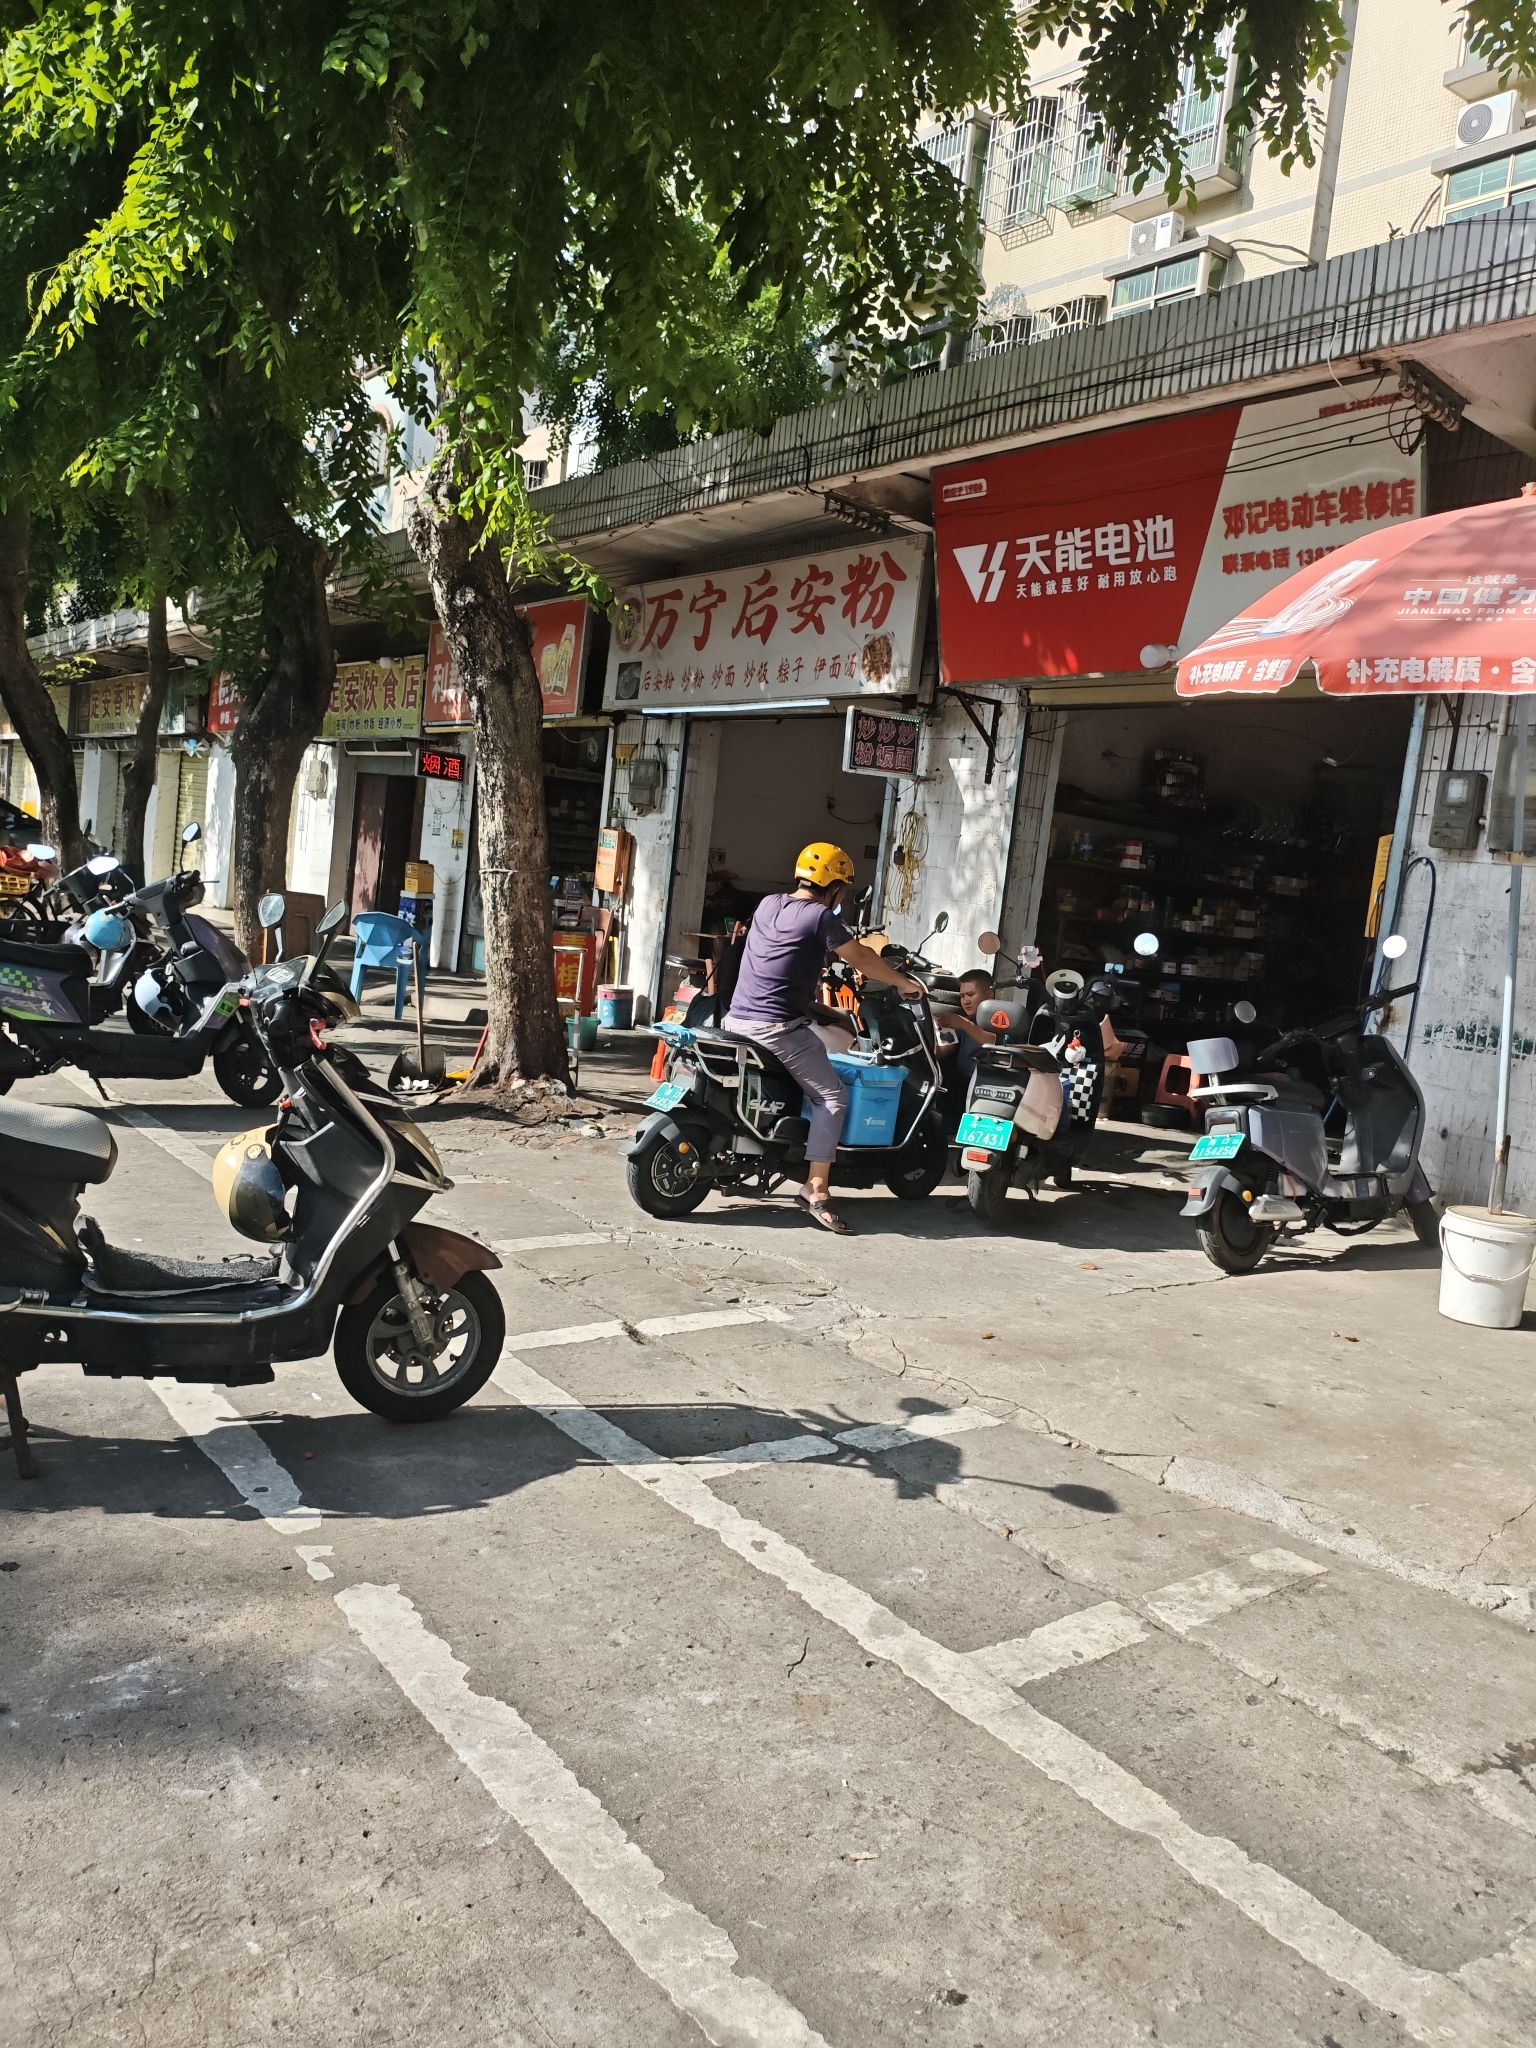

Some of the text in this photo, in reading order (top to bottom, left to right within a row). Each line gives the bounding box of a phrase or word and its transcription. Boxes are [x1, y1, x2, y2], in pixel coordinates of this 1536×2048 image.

[1223, 478, 1415, 540] 邓记电动车维修店
[1016, 515, 1175, 579] 天能电池
[1222, 547, 1290, 575] 联系电话
[1016, 565, 1178, 600] 天能就是好 耐用放心跑
[1465, 574, 1518, 585] 这就是
[638, 551, 908, 652] 万宁后安粉
[1397, 607, 1471, 615] JIANLIBAO
[1477, 607, 1517, 615] FROM
[641, 667, 675, 692] 后安粉
[681, 665, 705, 692] 炒粉
[711, 663, 736, 690] 炒面
[743, 660, 769, 688] 炒饭
[813, 653, 857, 681] 伊面汤
[422, 752, 461, 779] 烟酒
[961, 1128, 1005, 1147] 167431
